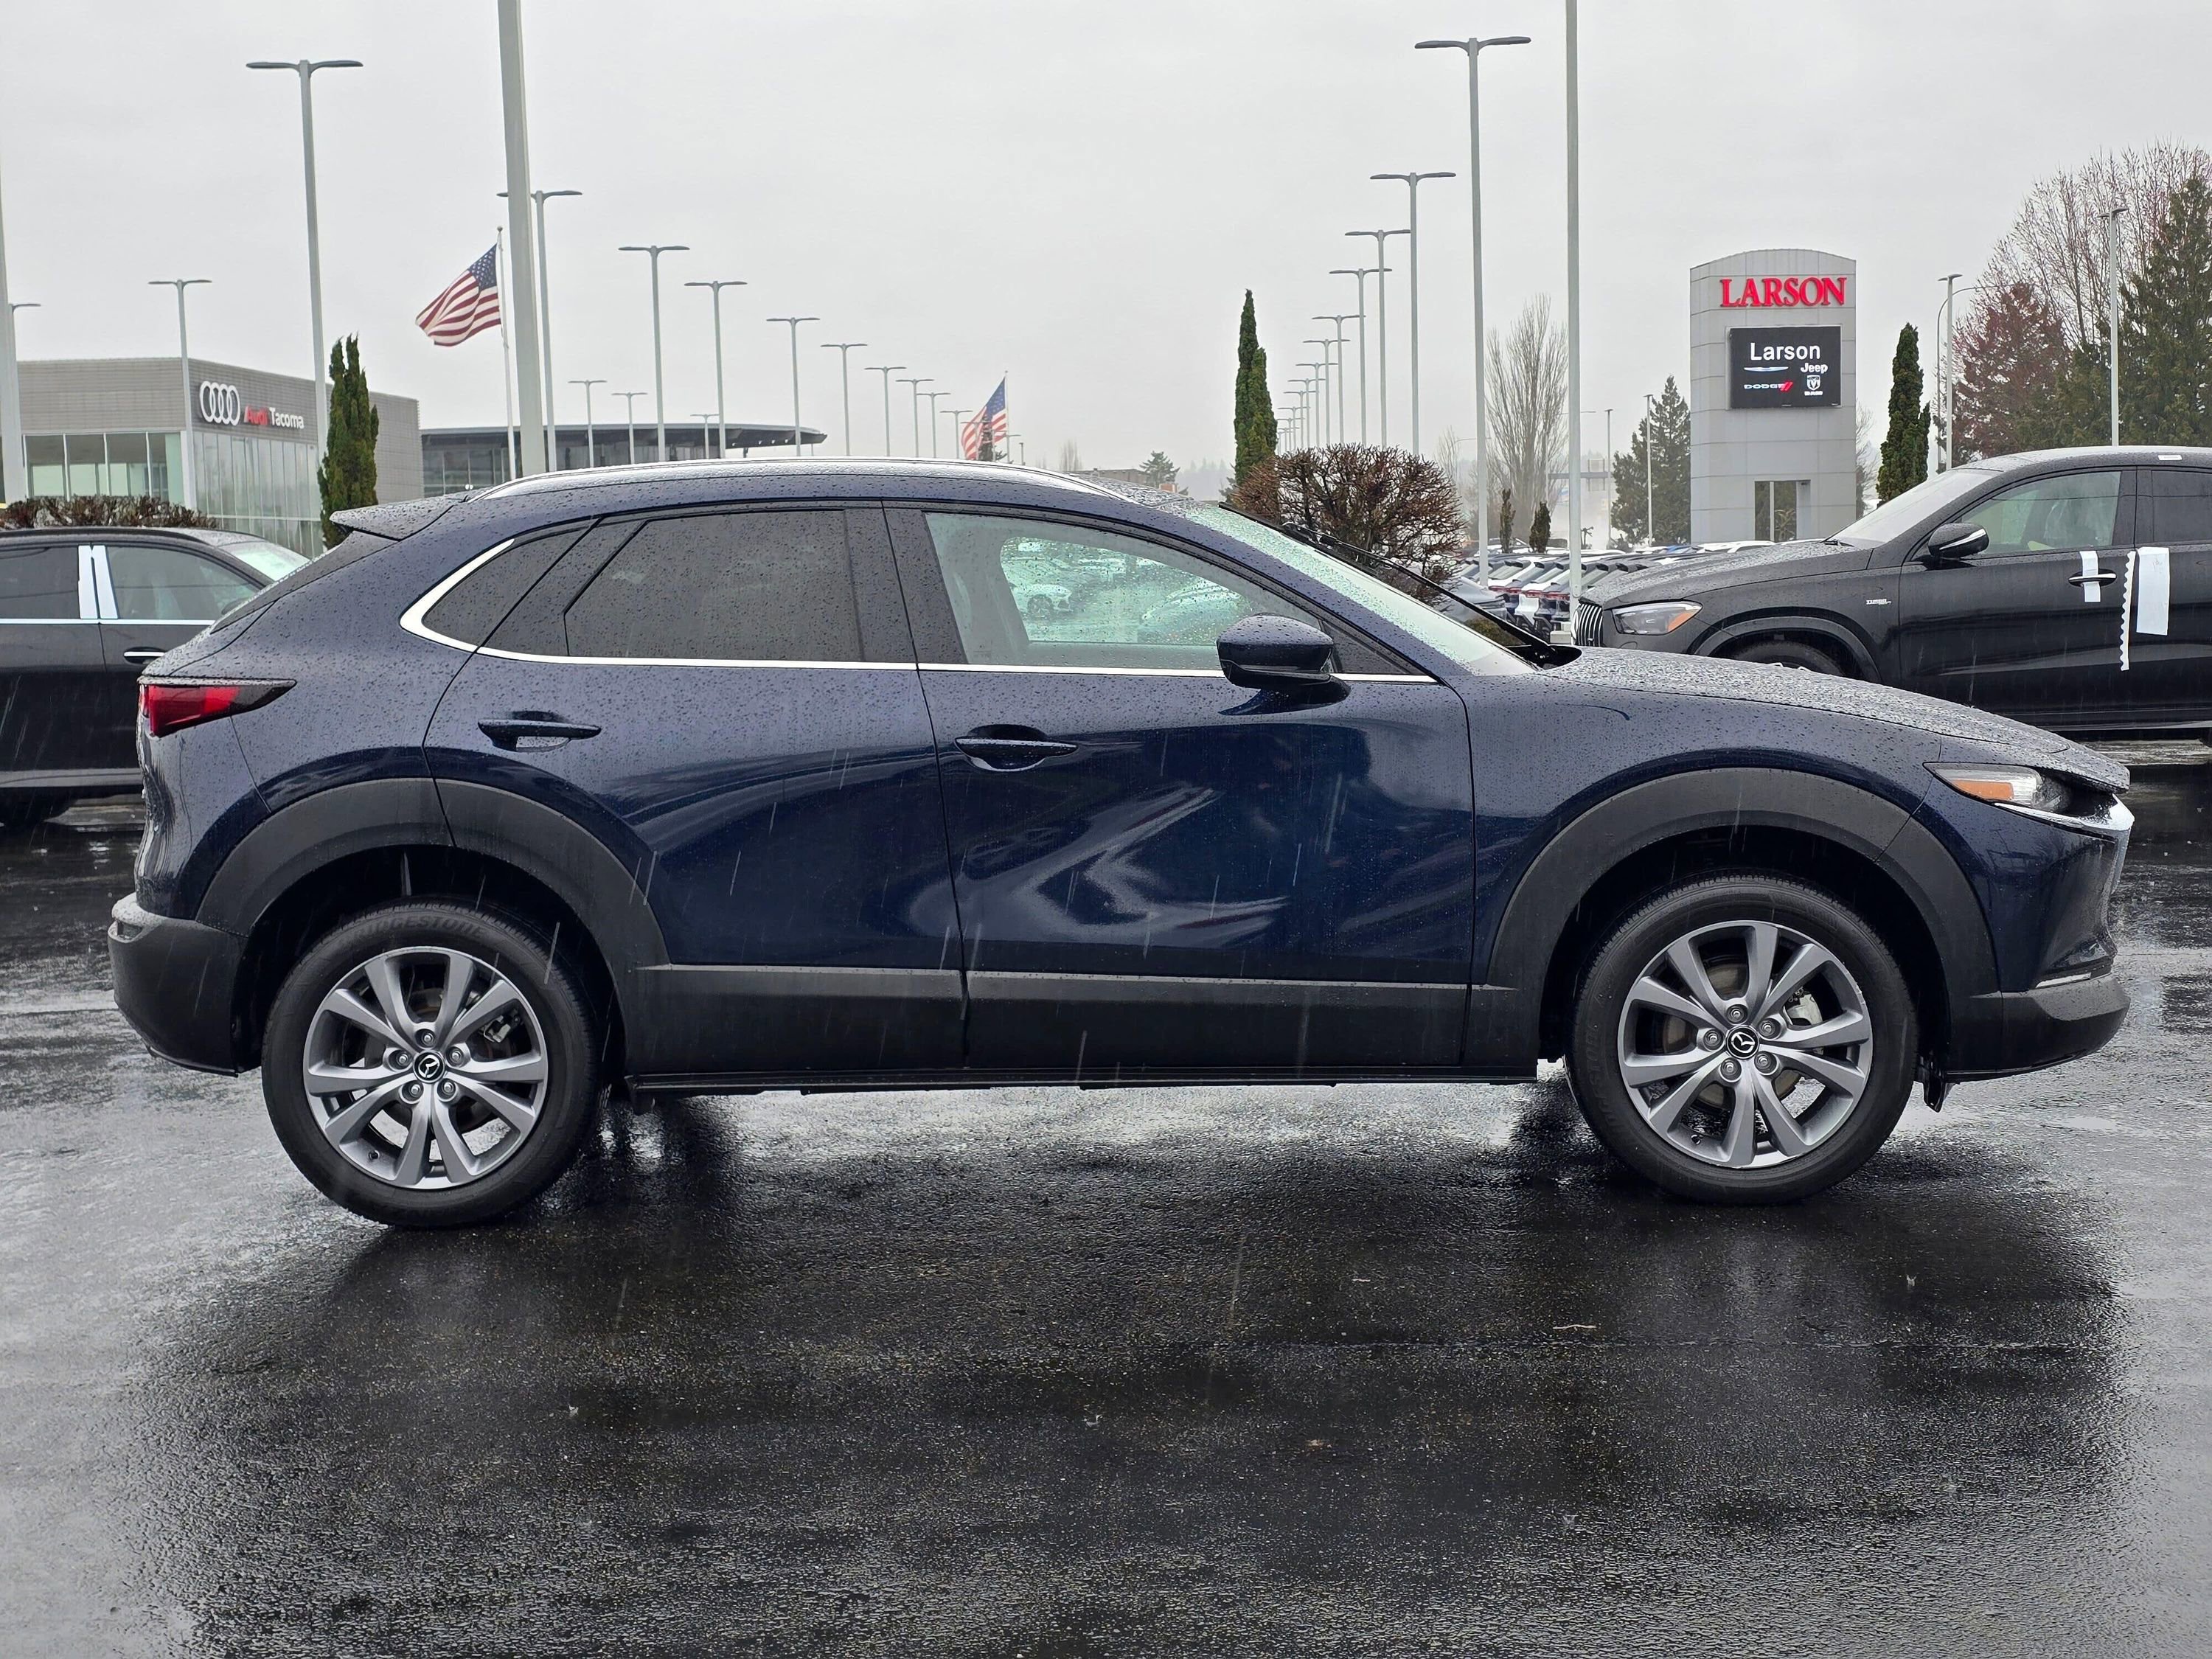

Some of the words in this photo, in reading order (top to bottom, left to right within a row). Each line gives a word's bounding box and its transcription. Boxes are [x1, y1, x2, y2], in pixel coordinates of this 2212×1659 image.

[1719, 277, 1847, 307] LARSON
[1750, 342, 1820, 361] Larson
[1801, 363, 1828, 374] Jeep
[244, 405, 268, 425] Audi
[269, 407, 305, 429] Tacoma
